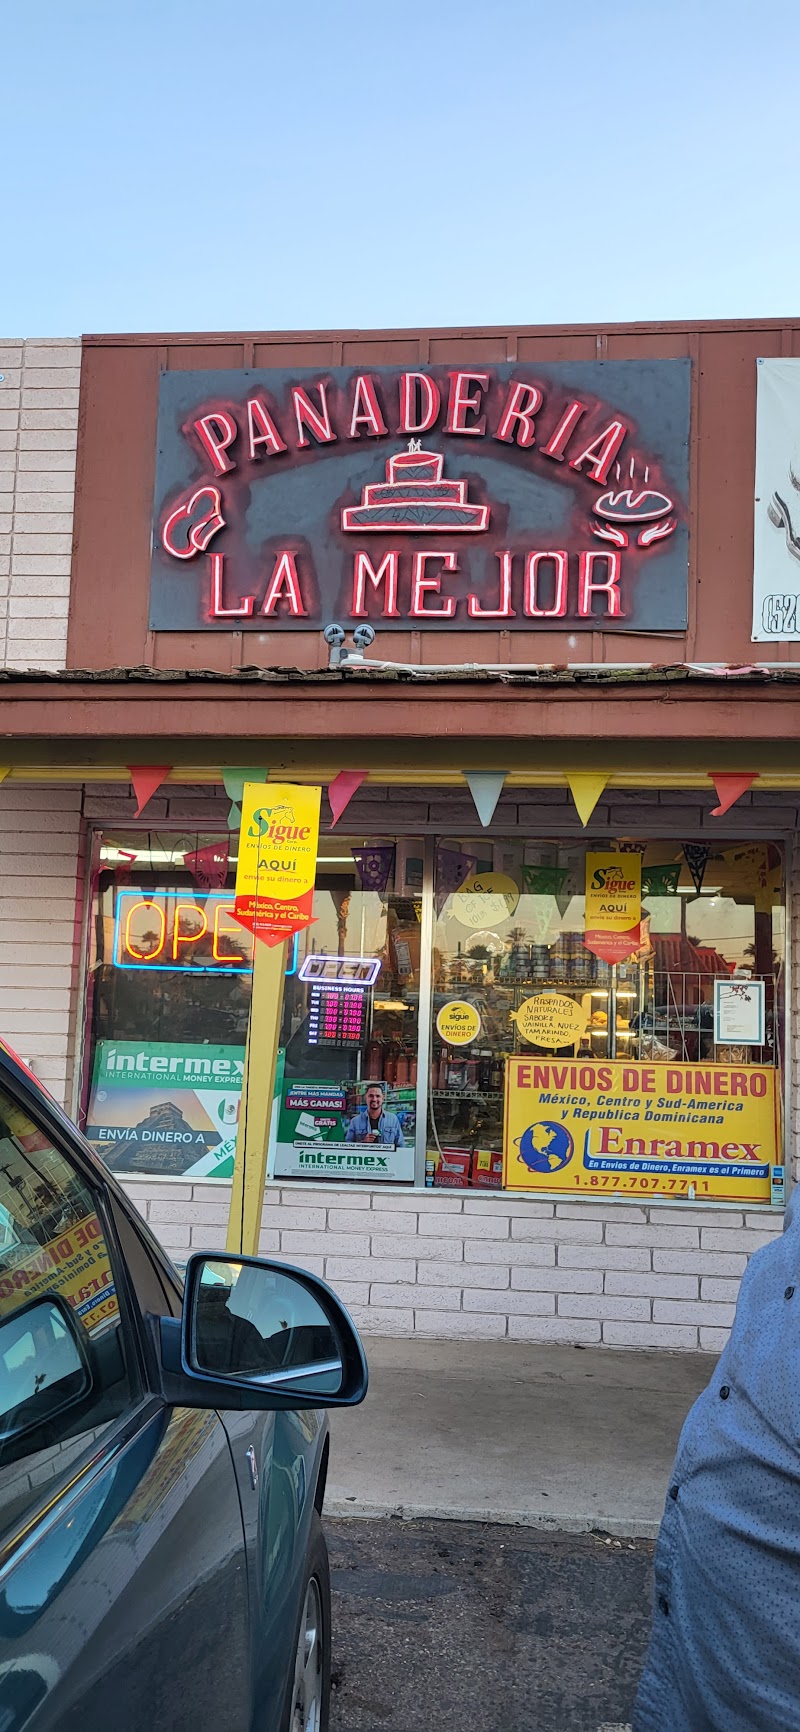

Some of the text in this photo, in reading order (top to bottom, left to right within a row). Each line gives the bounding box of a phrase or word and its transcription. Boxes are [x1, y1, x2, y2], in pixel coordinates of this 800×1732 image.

[194, 371, 628, 486] PANADERIA
[206, 550, 626, 619] LA MEJOR
[247, 807, 311, 845] Sigue
[258, 859, 298, 871] AQUÍ
[243, 874, 265, 882] envie
[277, 876, 302, 884] dinero
[591, 868, 636, 894] Sigue
[236, 908, 274, 918] Sudamérica
[274, 912, 279, 920] y
[287, 912, 309, 921] Caribe
[275, 903, 299, 912] Centro,
[599, 903, 627, 912] AQUÍ
[125, 900, 255, 960] OPE
[304, 960, 377, 981] OPEN
[533, 996, 574, 1009] RASPADOS
[449, 1013, 470, 1021] sigue
[557, 1023, 581, 1031] NUEZ
[106, 1048, 245, 1076] intermex
[105, 1071, 244, 1084] INTERNATIONAL MONEY EXPRE
[517, 1065, 767, 1098] ENVIOS DE DINERO
[289, 1098, 342, 1108] MÁS GANAS!
[539, 1093, 744, 1112] México, Centro y Sud-America
[560, 1108, 724, 1125] y Republica Dominicana
[98, 1127, 205, 1144] ENVÍA DINERO A
[596, 1126, 762, 1162] Enramex
[299, 1150, 388, 1166] intermex
[588, 1160, 599, 1168] En
[629, 1161, 640, 1170] de
[641, 1162, 671, 1173] Dinero,
[672, 1163, 707, 1173] Enramex
[721, 1165, 730, 1174] el
[732, 1166, 765, 1176] Primero
[574, 1174, 710, 1192] 1.877.707.7711
